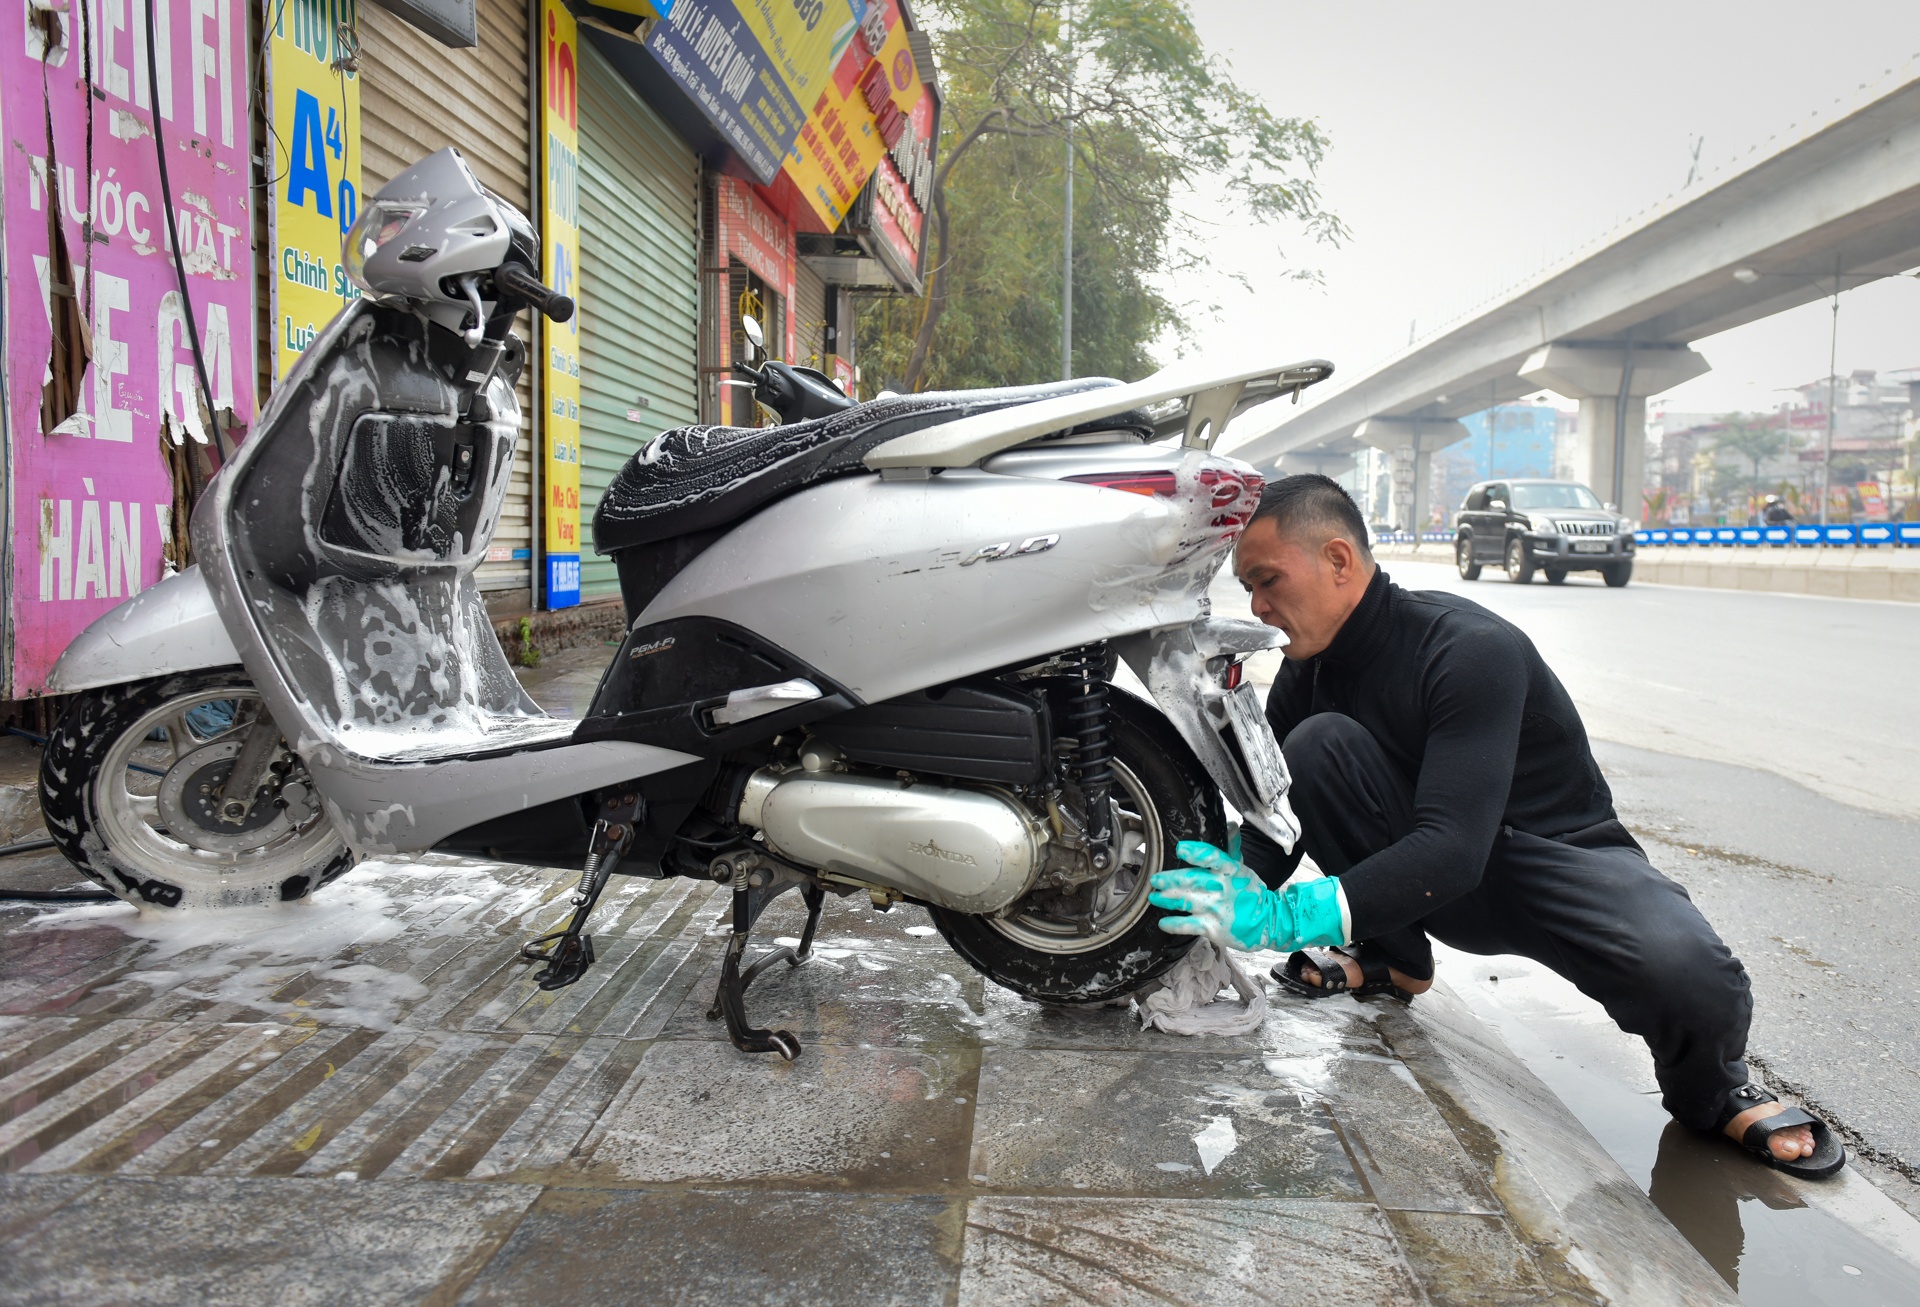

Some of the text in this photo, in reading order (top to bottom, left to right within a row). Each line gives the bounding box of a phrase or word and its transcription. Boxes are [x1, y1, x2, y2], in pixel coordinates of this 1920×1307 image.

[190, 0, 234, 149] FI
[548, 9, 576, 132] in
[720, 51, 756, 104] QUÂN
[549, 131, 578, 230] PHOTO
[283, 246, 328, 292] Chỉnh
[39, 477, 142, 602] HÀN
[907, 840, 978, 867] HONDA
